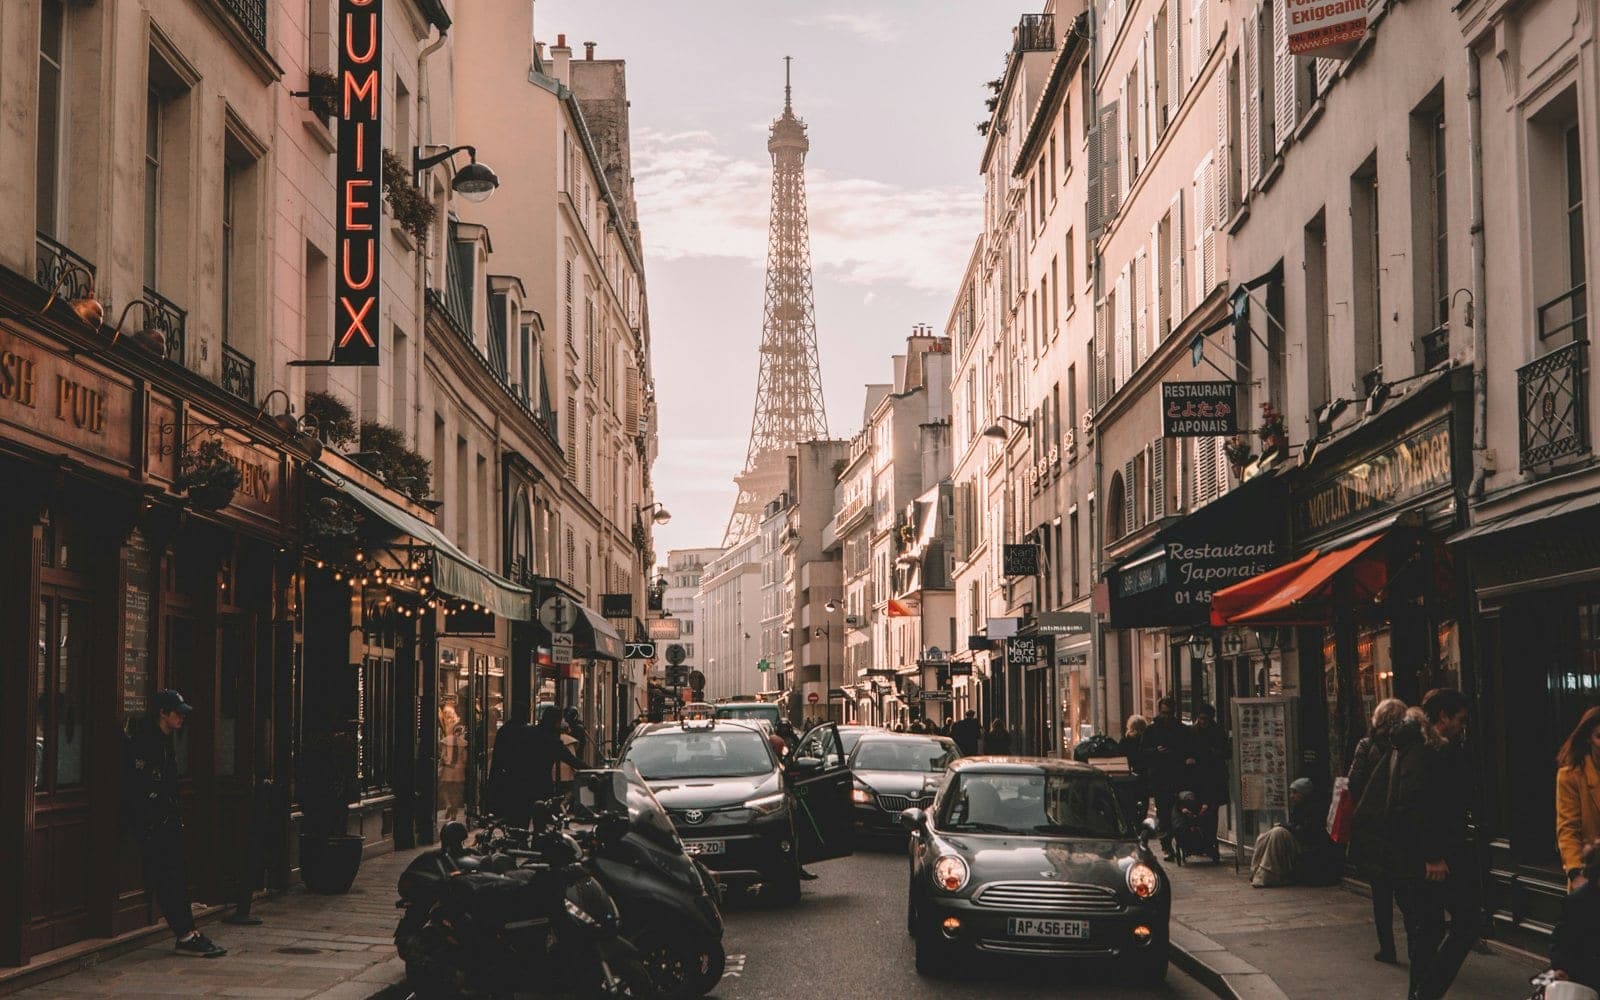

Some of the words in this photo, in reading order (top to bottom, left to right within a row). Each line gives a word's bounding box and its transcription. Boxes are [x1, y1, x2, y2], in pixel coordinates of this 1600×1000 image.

[338, 0, 378, 348] UMIEUX
[1164, 384, 1232, 397] RESTAURANT
[1167, 401, 1231, 417] とよたか
[1171, 420, 1228, 433] JAPONAIS
[1168, 540, 1275, 560] Restaurant
[1180, 562, 1266, 584] Japonais
[1175, 591, 1191, 604] 01
[1195, 590, 1212, 603] 45
[1009, 647, 1035, 656] Marc
[1013, 640, 1035, 649] Karl
[1009, 655, 1035, 664] John
[1017, 920, 1080, 936] AP-456-EH
